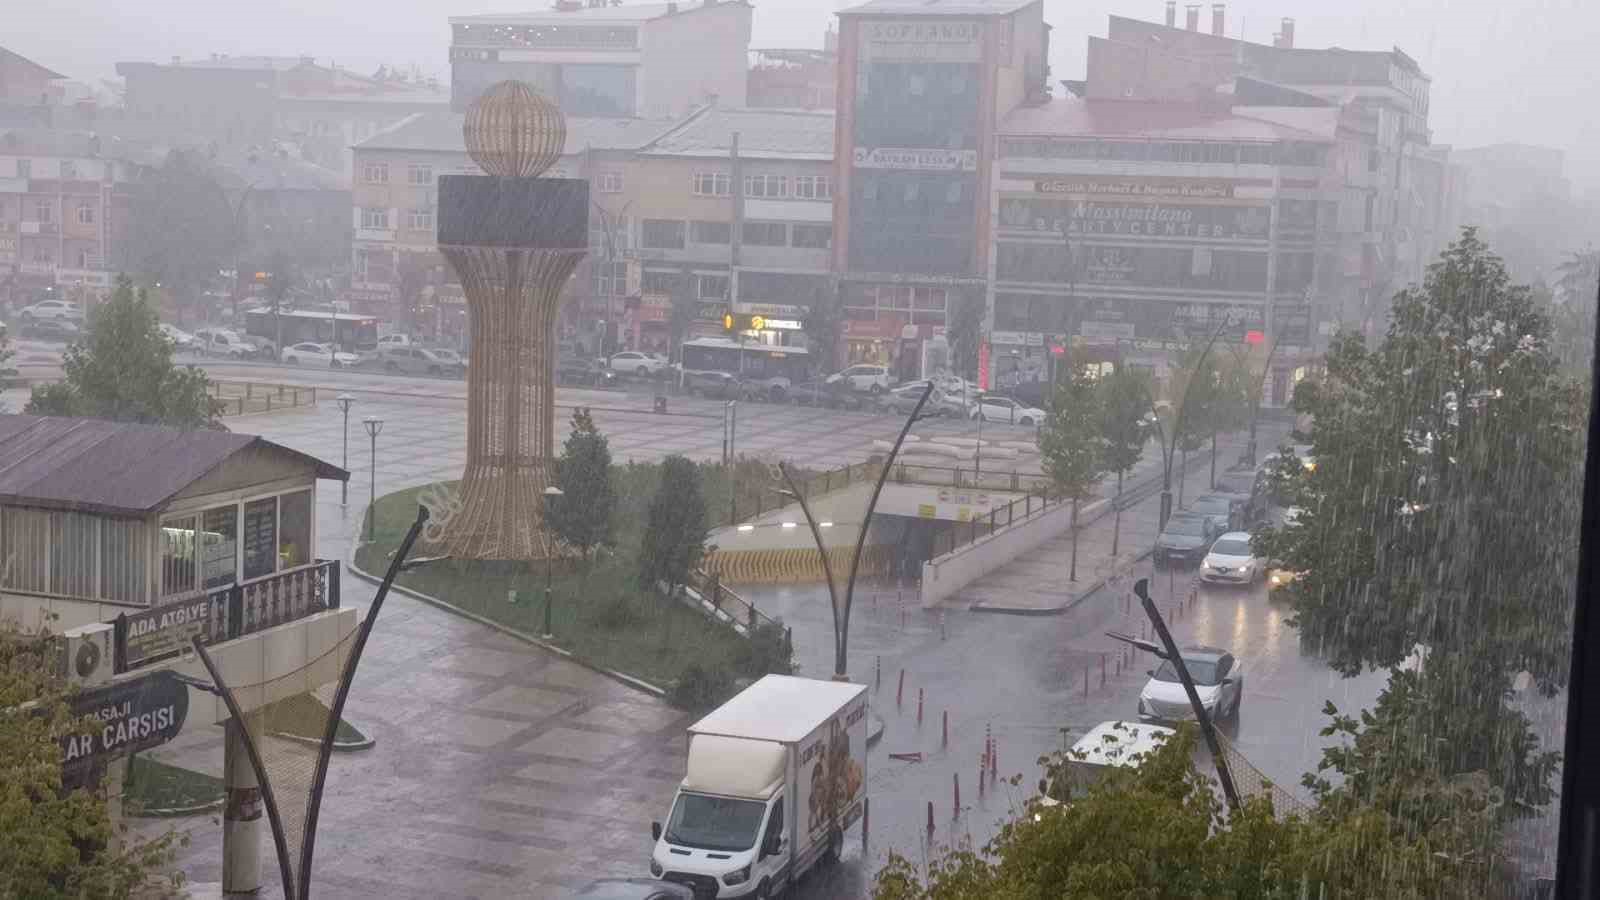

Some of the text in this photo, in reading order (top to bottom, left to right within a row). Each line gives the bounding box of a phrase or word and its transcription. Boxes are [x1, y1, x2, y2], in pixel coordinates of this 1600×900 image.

[1130, 222, 1224, 237] CENTER
[128, 618, 157, 638] ADA
[60, 704, 175, 762] AR ÇARŞISI
